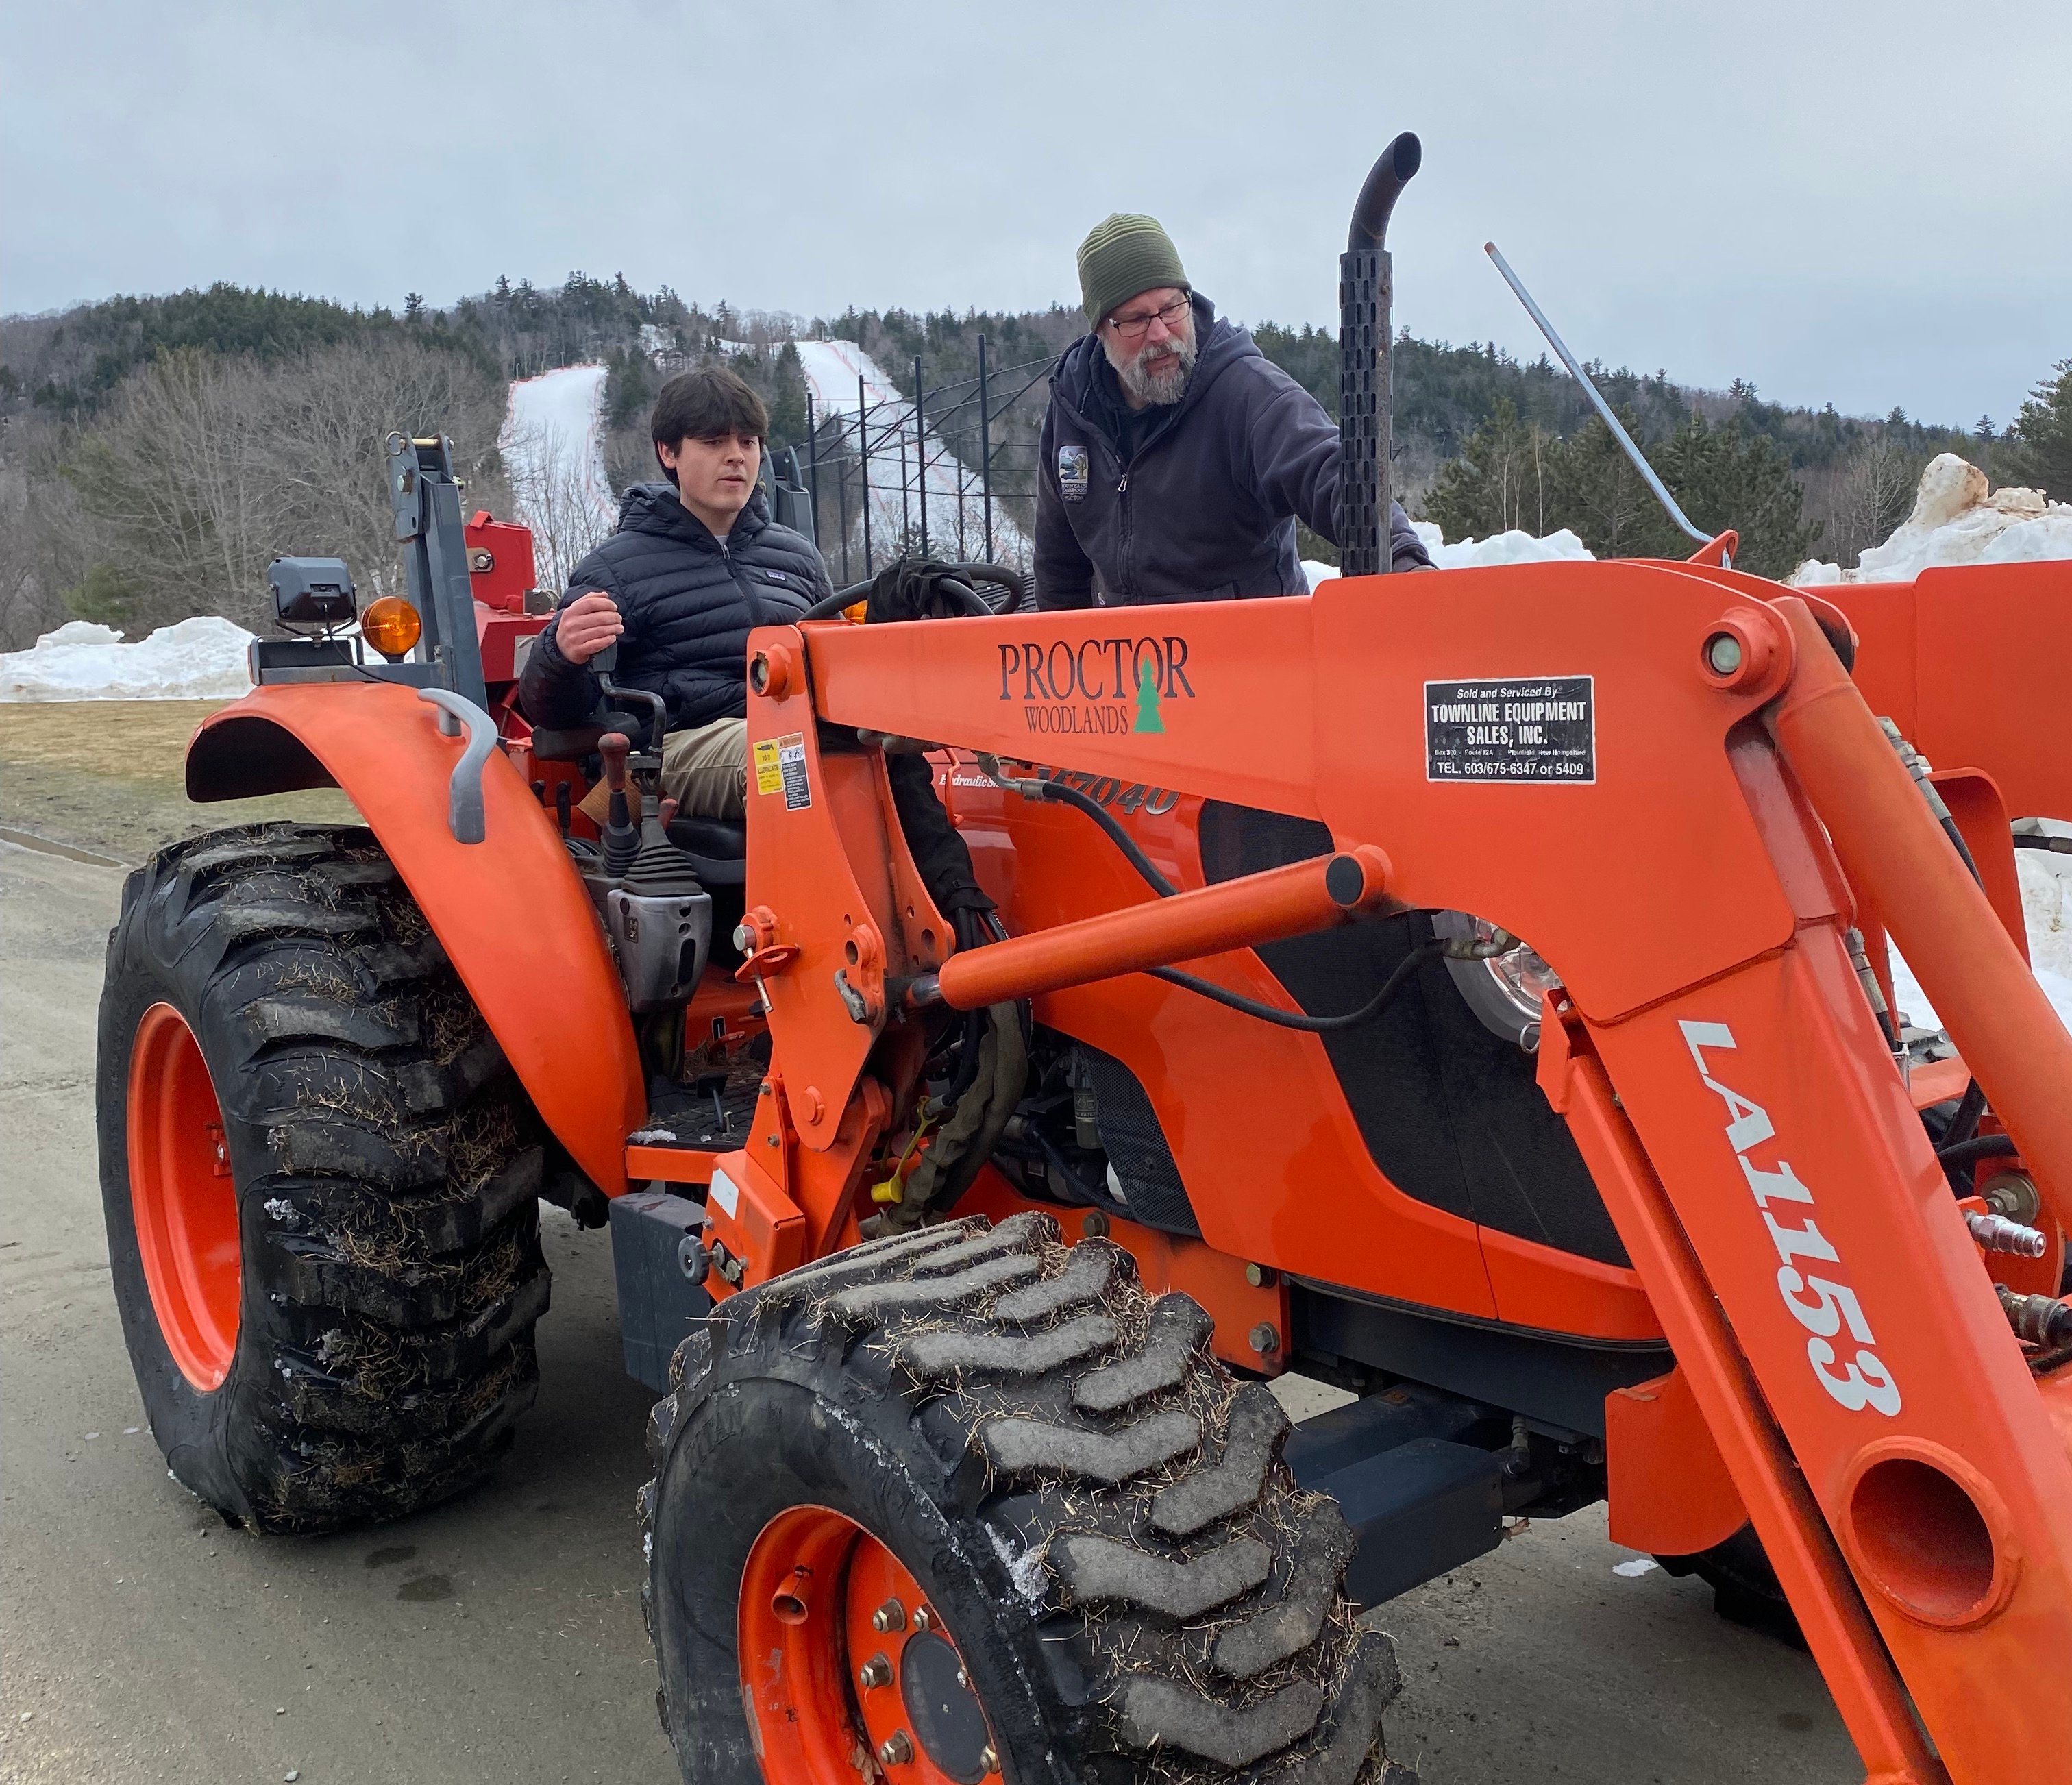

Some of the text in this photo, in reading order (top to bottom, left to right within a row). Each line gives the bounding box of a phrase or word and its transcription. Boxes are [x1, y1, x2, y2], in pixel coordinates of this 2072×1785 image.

[998, 637, 1196, 700] PROCTOR
[1457, 686, 1558, 699] Sold and Serviced By
[1024, 705, 1128, 735] WOODLANDS
[1432, 702, 1586, 724] TOWNLINE EQUIPMENT
[1467, 725, 1549, 748] SALES, INC.
[1437, 762, 1583, 775] TEL. 603/675-6347 or 5409
[939, 774, 987, 787] Hdraulic
[1677, 1020, 1902, 1417] LA1153
